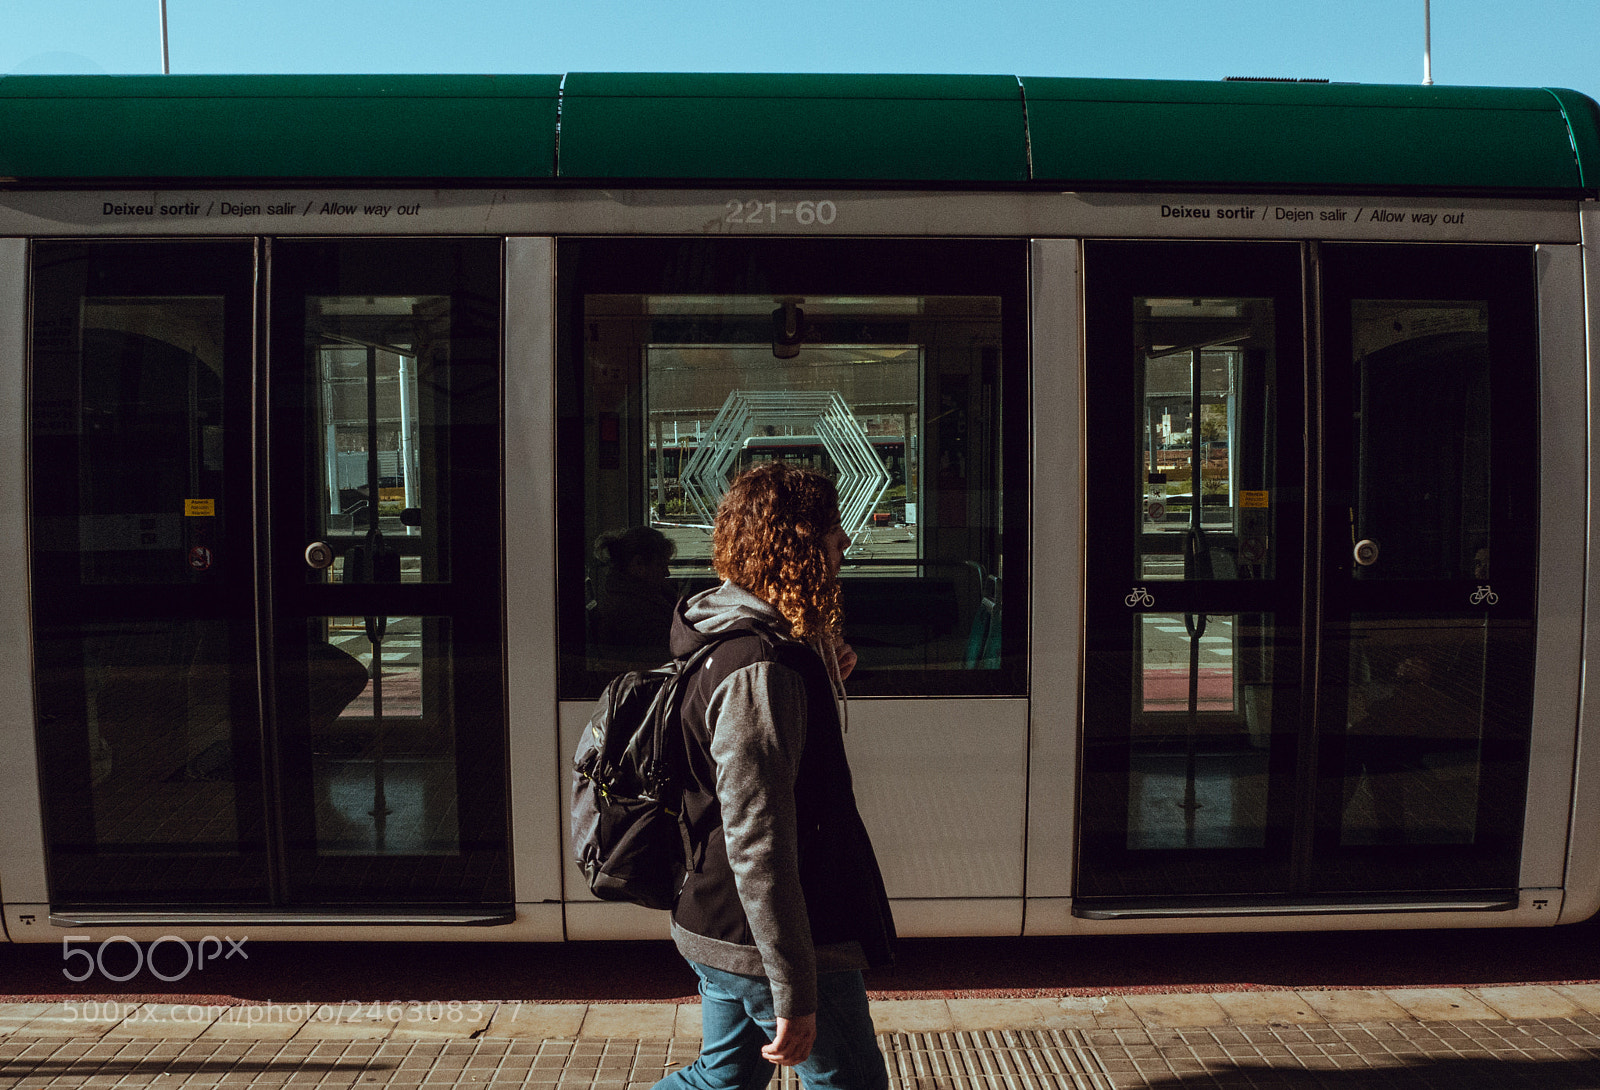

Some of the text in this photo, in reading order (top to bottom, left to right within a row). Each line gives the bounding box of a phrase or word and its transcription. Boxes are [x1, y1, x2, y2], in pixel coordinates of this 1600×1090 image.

[103, 202, 154, 216] Deixeu
[160, 201, 200, 216] sortir
[220, 202, 261, 217] Dejen
[267, 201, 297, 216] salir
[319, 201, 358, 216] Allow
[364, 205, 391, 218] way
[397, 203, 421, 216] out
[726, 199, 837, 225] 221-60
[1161, 205, 1210, 219] Deixeu
[1216, 206, 1255, 220] sortir
[1275, 207, 1314, 223] Dejen
[1320, 207, 1348, 222] salir
[1370, 209, 1405, 223] Allow
[1412, 212, 1437, 225] way
[1443, 211, 1465, 225] out
